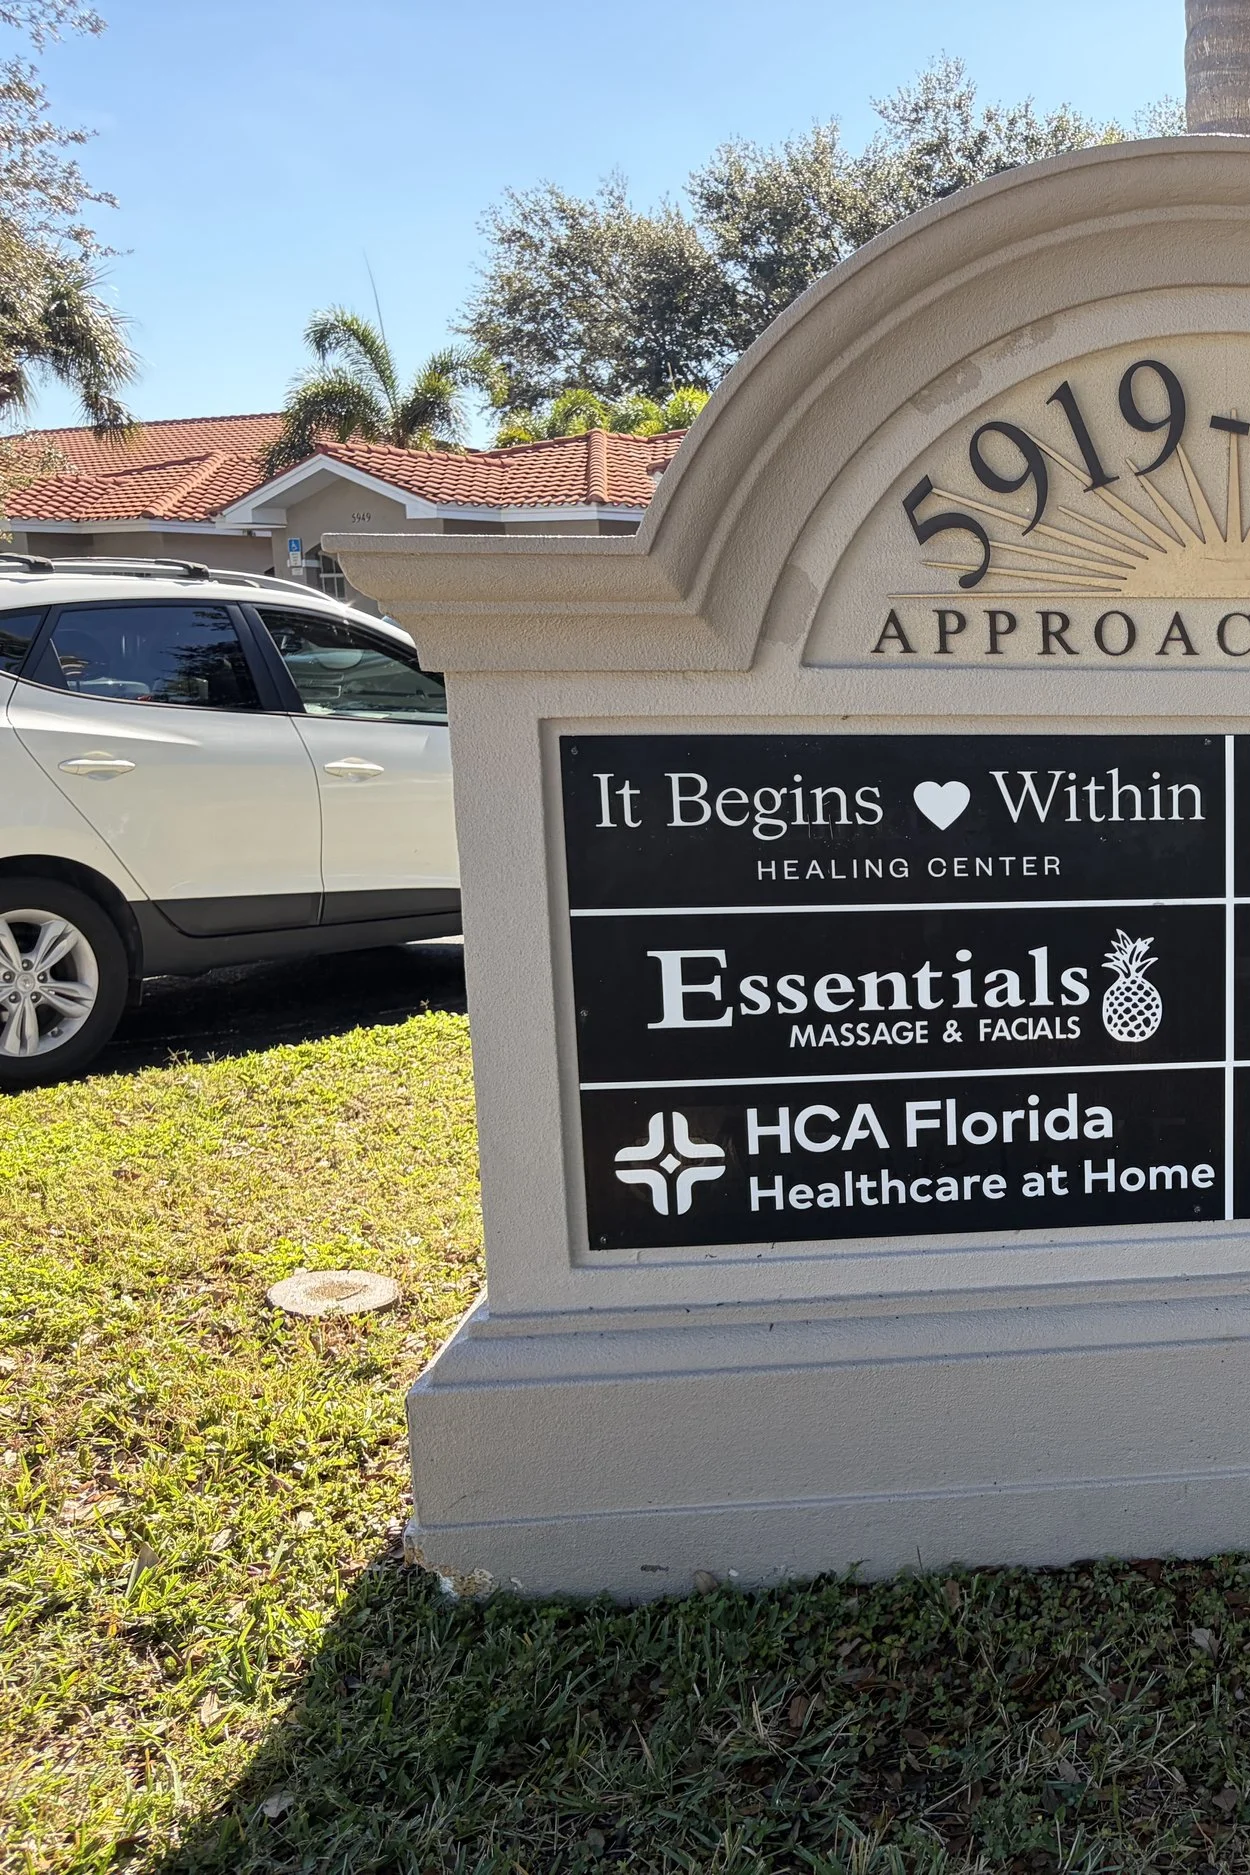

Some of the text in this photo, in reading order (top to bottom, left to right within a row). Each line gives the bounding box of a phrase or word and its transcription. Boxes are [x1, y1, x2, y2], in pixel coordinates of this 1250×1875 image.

[593, 768, 1205, 840] It Begins Within
[758, 857, 1059, 880] HEALING CENTER
[647, 947, 1089, 1029] Essentials
[790, 1016, 1080, 1047] MASSAGE & FACIALS
[747, 1093, 1112, 1154] HCA Florida
[750, 1159, 1214, 1211] Healthcare at Home
